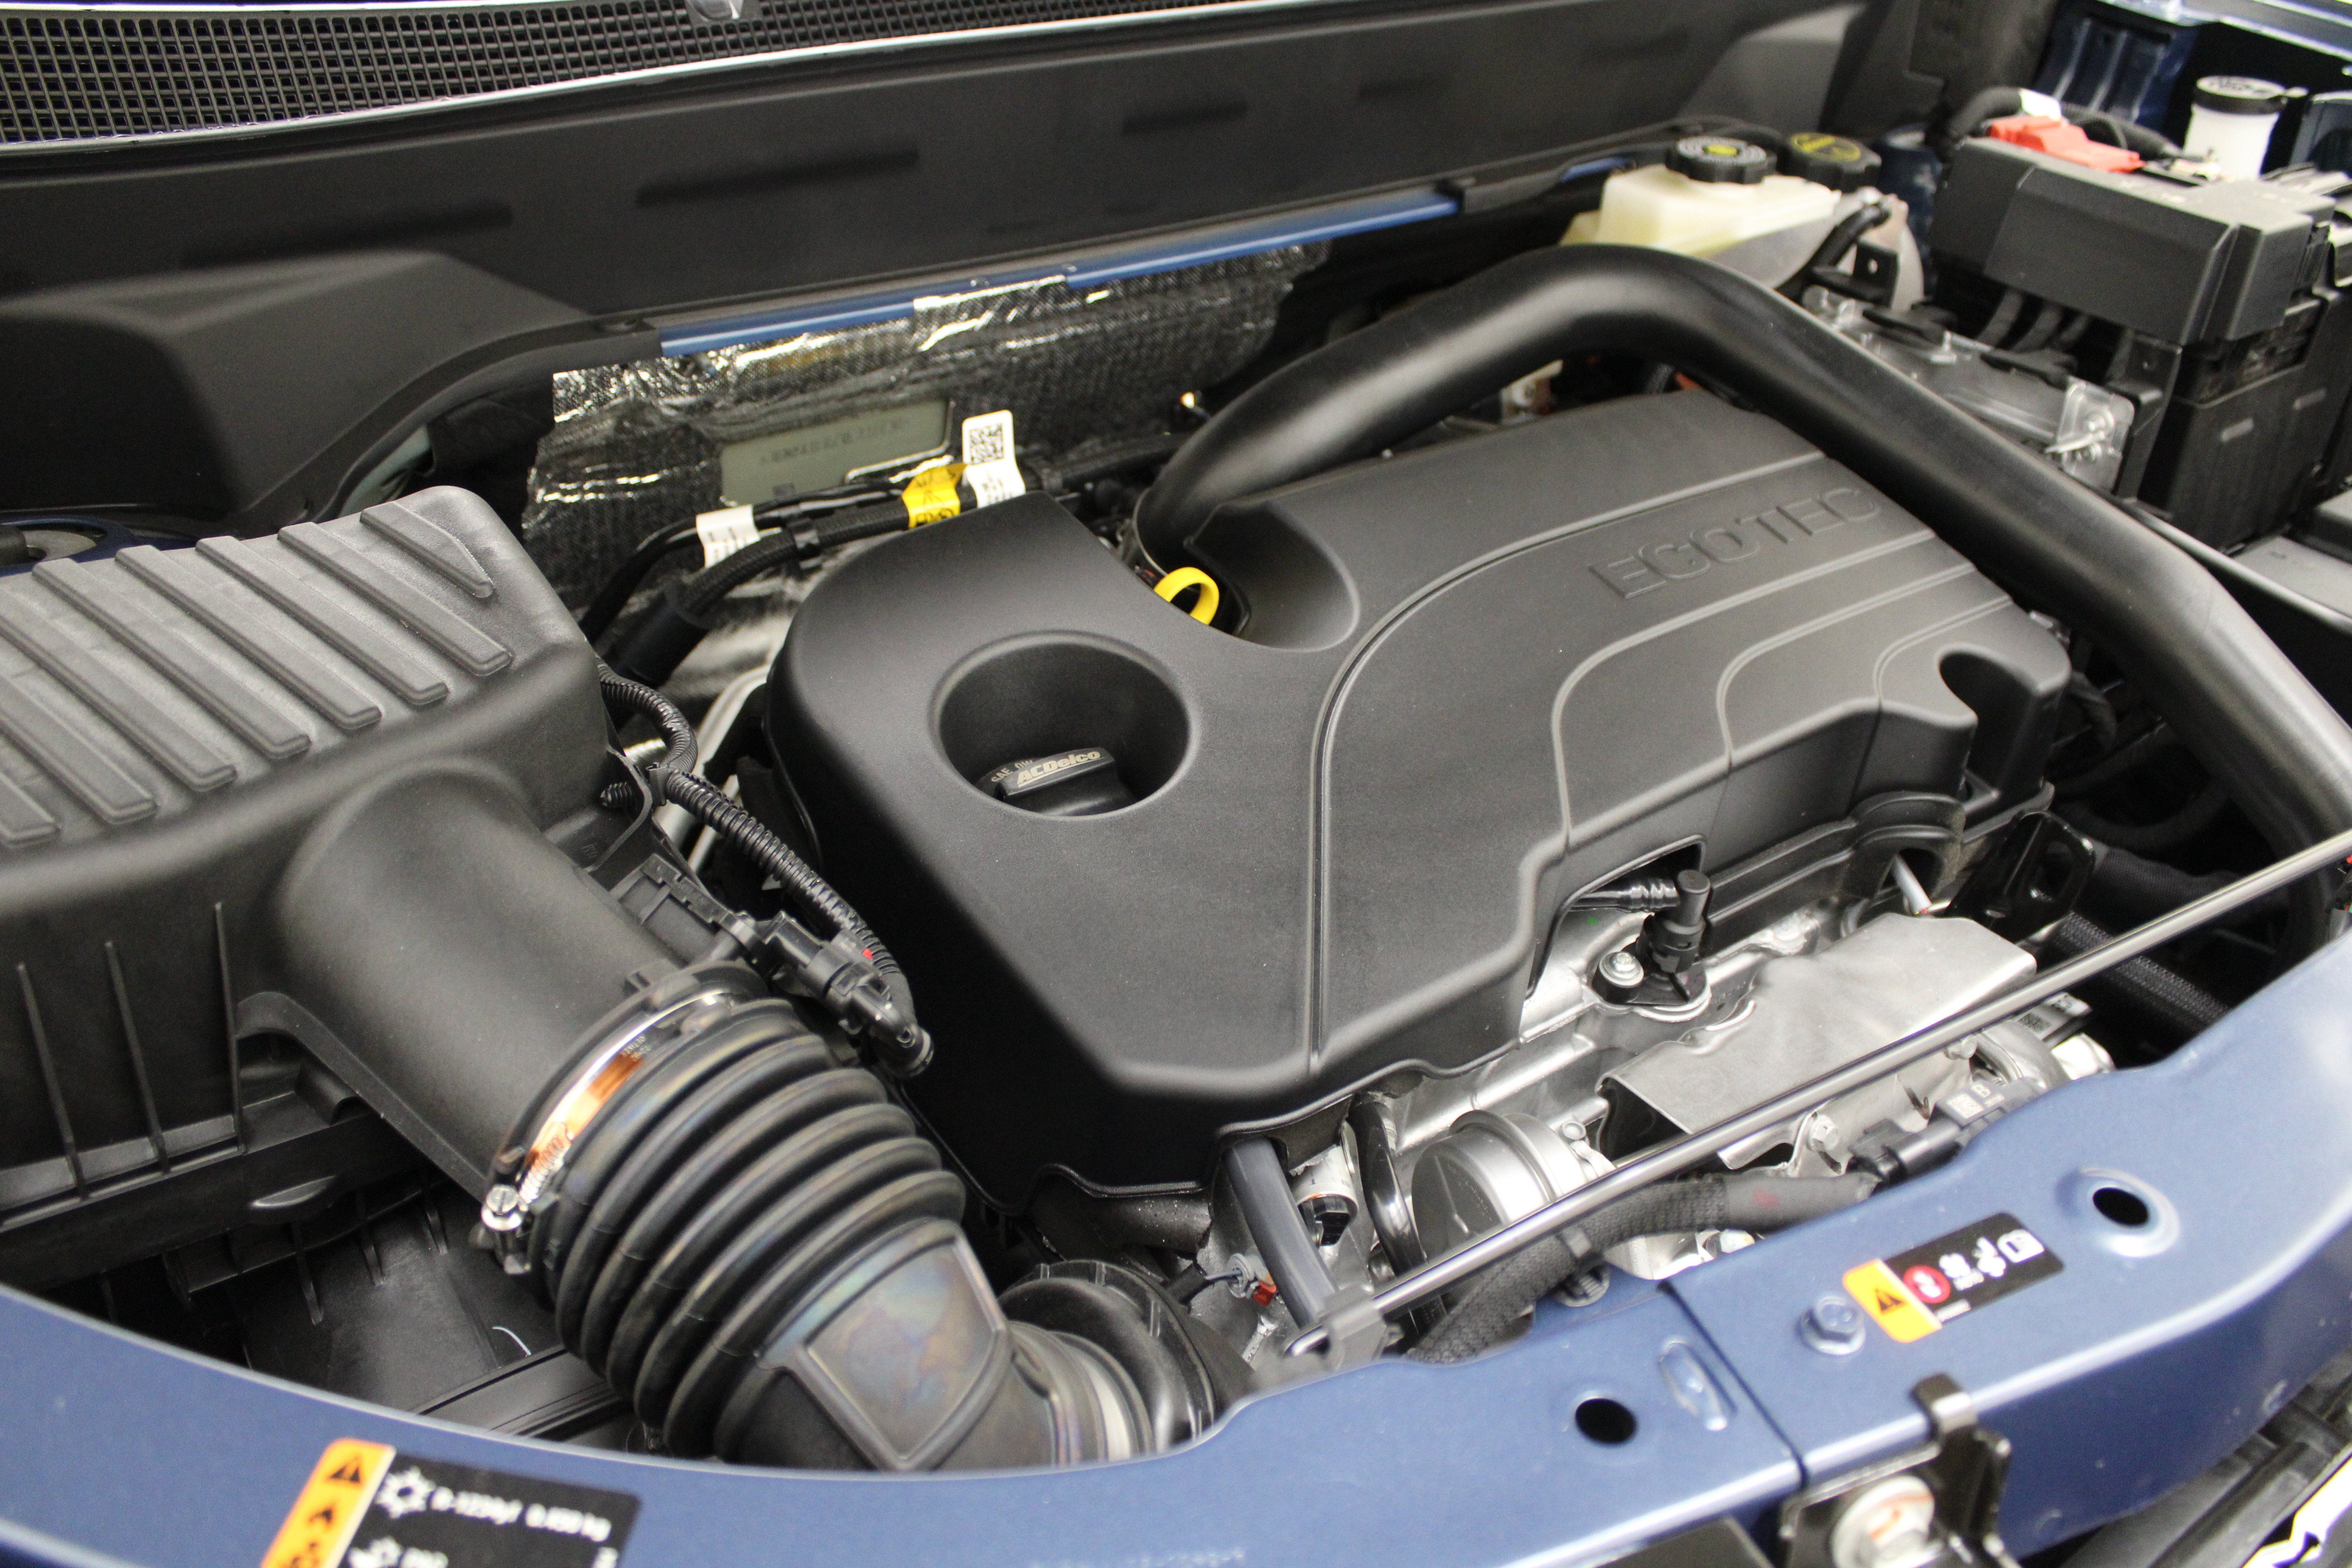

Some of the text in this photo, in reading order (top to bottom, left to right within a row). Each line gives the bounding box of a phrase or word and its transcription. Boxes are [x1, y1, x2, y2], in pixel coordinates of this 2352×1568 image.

[1588, 487, 1881, 599] ECOTEC
[991, 767, 1013, 782] SAE
[1016, 751, 1101, 785] ACDelco
